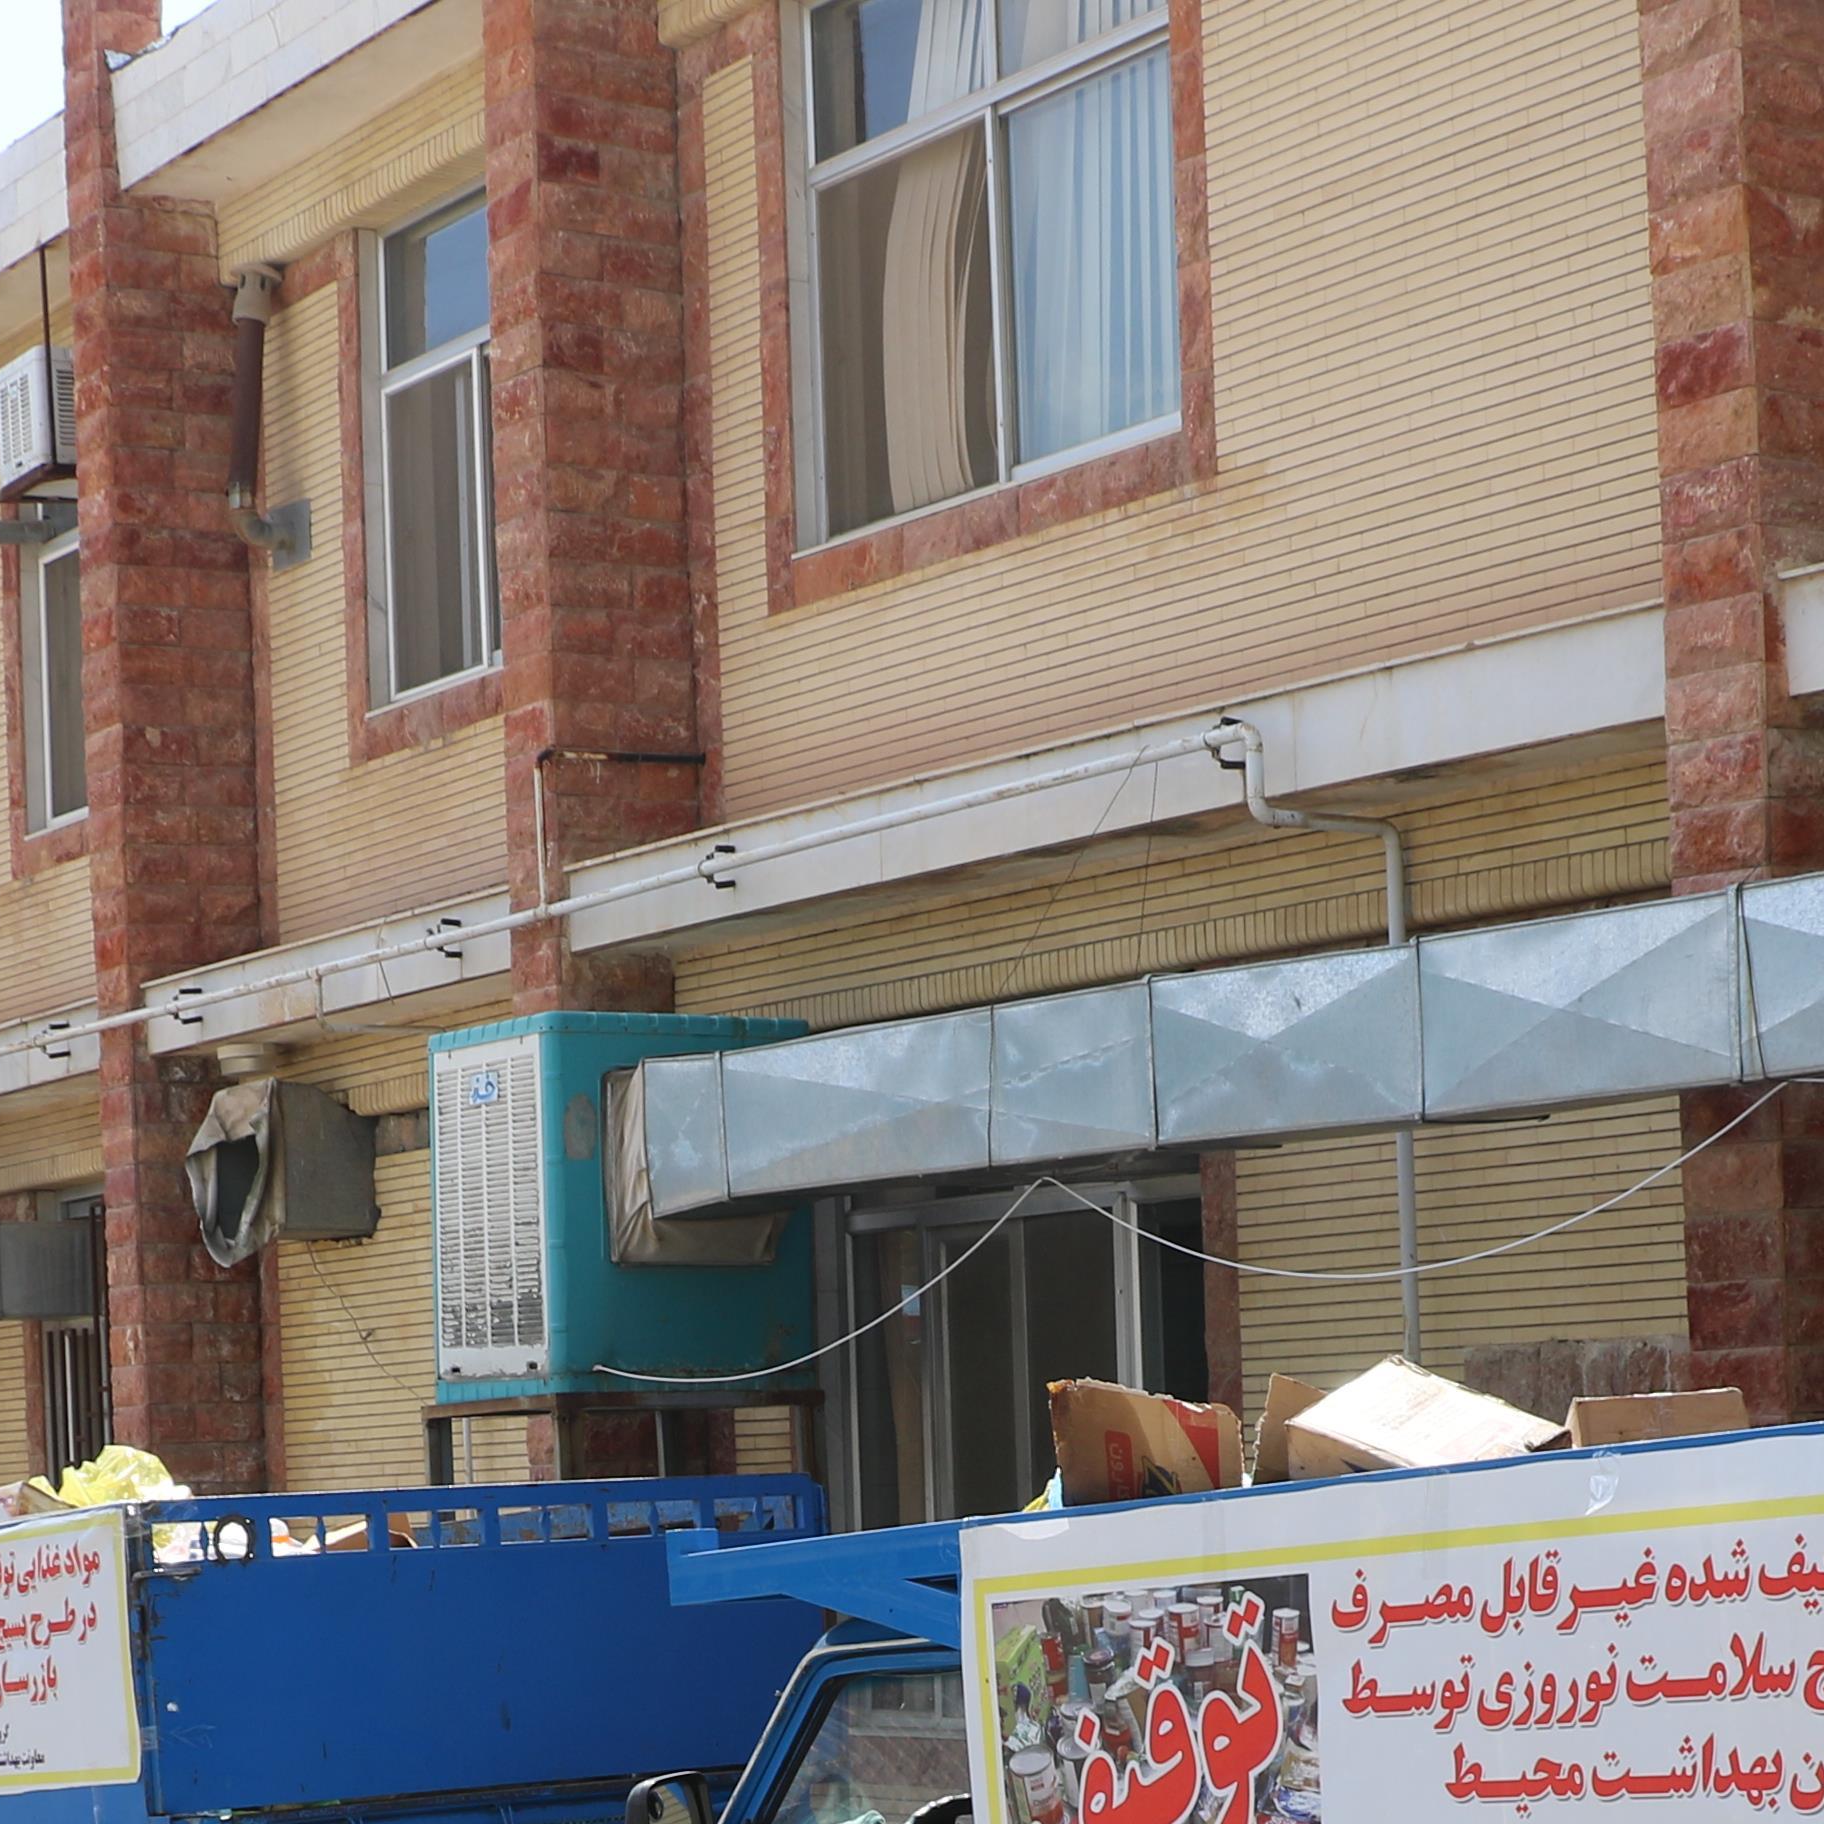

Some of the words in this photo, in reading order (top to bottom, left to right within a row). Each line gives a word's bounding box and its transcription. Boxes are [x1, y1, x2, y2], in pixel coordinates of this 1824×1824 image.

[17, 1543, 61, 1594] غذایی
[64, 1539, 100, 1586] مواد
[1479, 1549, 1561, 1635] قابل
[1557, 1547, 1659, 1631] غیر
[1664, 1538, 1751, 1602] شده
[30, 1596, 76, 1646] طرح
[78, 1601, 97, 1642] در
[1330, 1569, 1474, 1645] مصرف
[1342, 1654, 1473, 1730] توسط
[1477, 1643, 1618, 1726] نوروزی
[1626, 1631, 1795, 1702] سلامت
[1444, 1743, 1584, 1816] محیط
[1592, 1733, 1783, 1808] بهداشت
